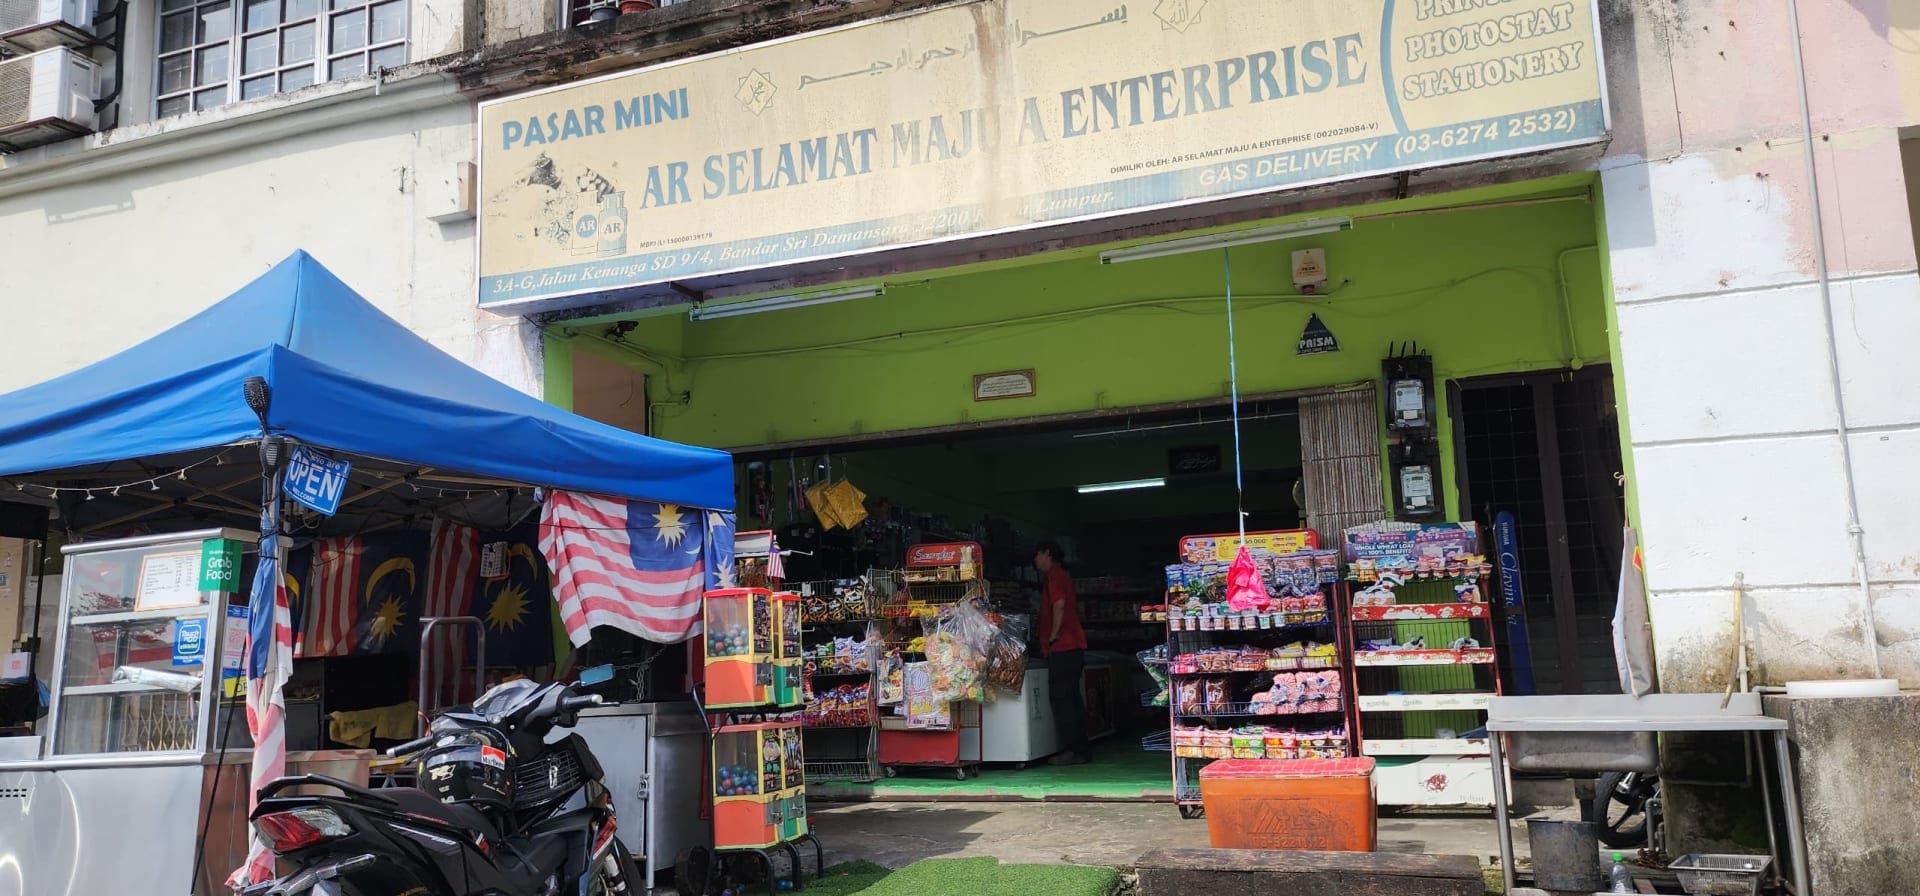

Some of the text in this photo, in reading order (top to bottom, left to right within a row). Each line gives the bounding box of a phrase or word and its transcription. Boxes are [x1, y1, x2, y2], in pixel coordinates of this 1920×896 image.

[1404, 3, 1574, 62] PHOTOSTAT
[1403, 41, 1584, 101] STATIONERY
[502, 88, 689, 150] PASAR MINI
[640, 32, 1368, 210] AR SELAMAT MAJU A ENTERPRISE
[1110, 163, 1144, 174] DIMILIKI
[1145, 157, 1171, 168] OLEH:
[1172, 155, 1184, 164] AR
[1184, 148, 1224, 162] SELAMAT
[1225, 144, 1250, 156] MAJU
[1260, 133, 1312, 150] ENTERPRISE
[1313, 121, 1379, 141] (002029084-V)
[1200, 108, 1576, 186] GAS DELIVERY (03-6274 2532)
[578, 220, 597, 233] AR
[580, 261, 646, 282] Kenanga
[650, 255, 676, 271] SD
[681, 249, 714, 266] 9/4,
[720, 241, 777, 261] Bandar
[783, 236, 807, 253] Sri
[812, 224, 909, 248] Damansara
[1037, 191, 1115, 214] Lumpur.
[604, 221, 620, 234] AR
[1300, 336, 1334, 349] PRISM
[290, 450, 341, 501] OPEN
[206, 569, 232, 580] Food
[208, 557, 233, 569] Grab
